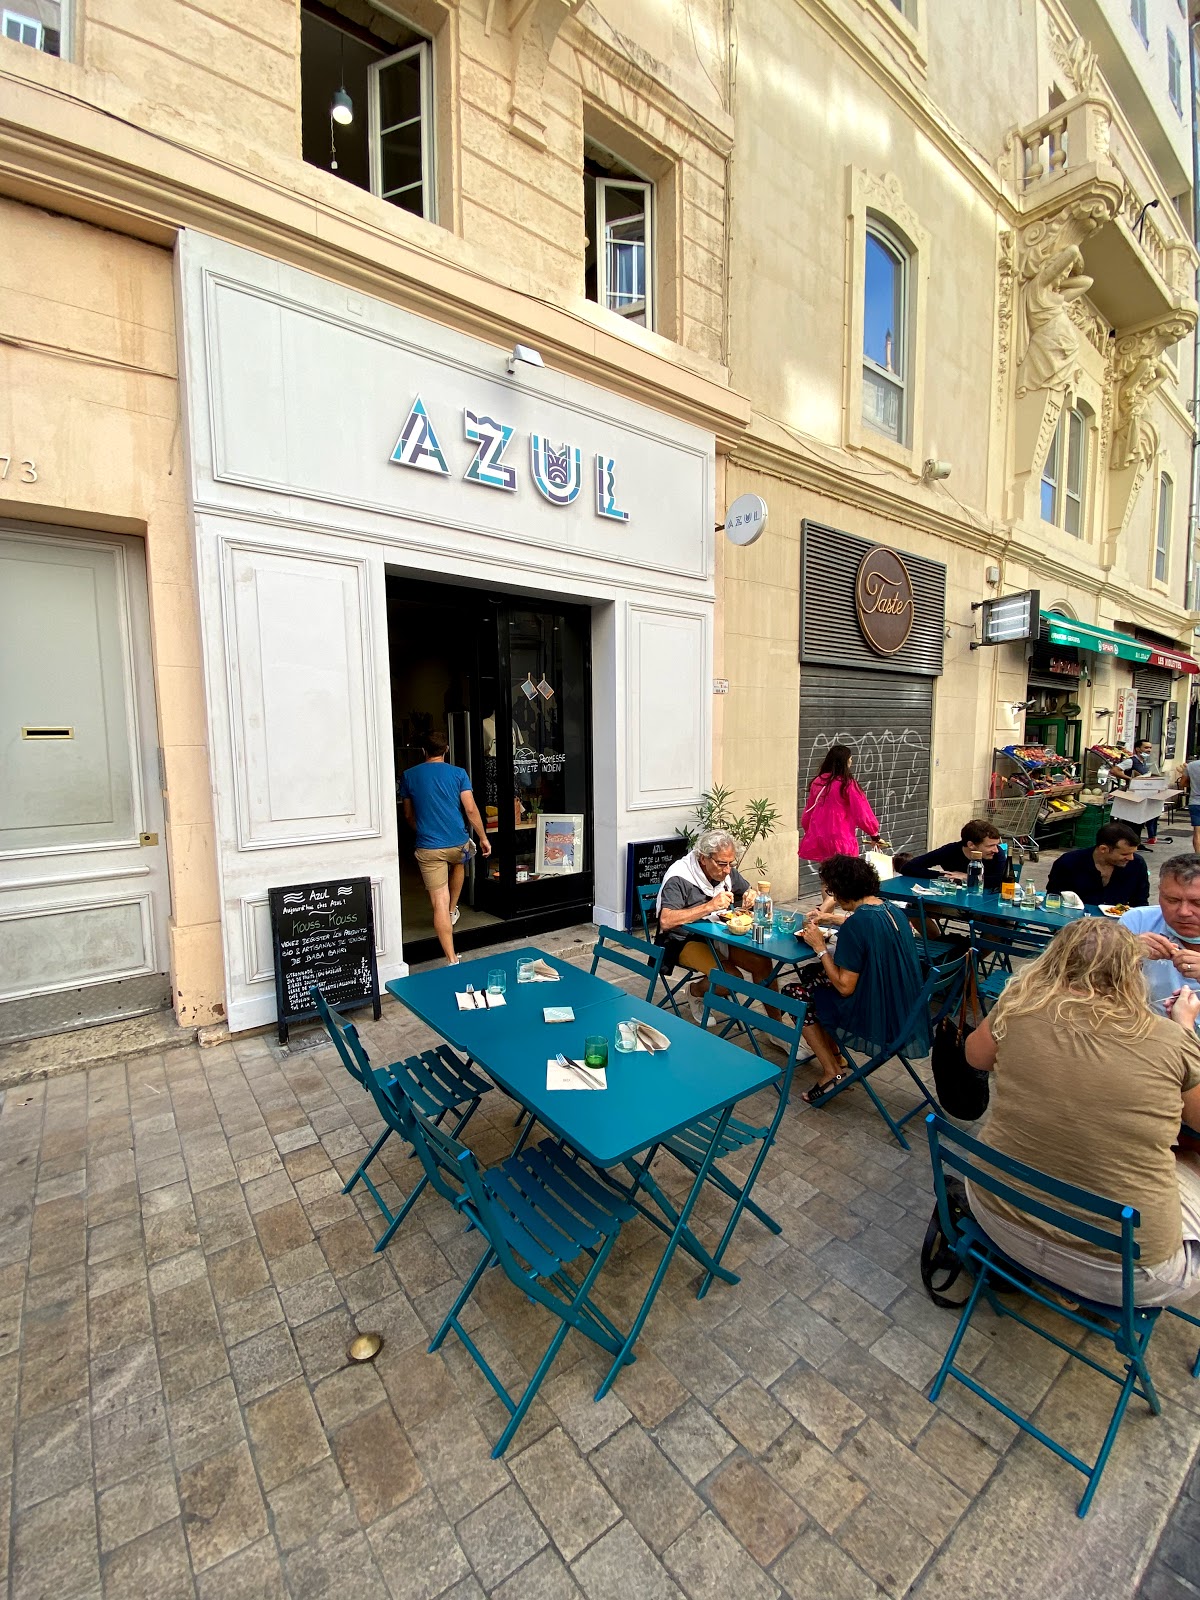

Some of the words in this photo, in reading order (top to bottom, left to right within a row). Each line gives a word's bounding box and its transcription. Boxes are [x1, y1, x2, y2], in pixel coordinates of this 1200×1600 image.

[388, 391, 630, 523] AZUL
[727, 510, 760, 529] AZUL
[864, 571, 914, 615] Taste
[1116, 695, 1125, 740] SANDWI
[538, 753, 566, 764] PROMESSE
[280, 939, 300, 949] VENEZ
[305, 951, 325, 963] BABA
